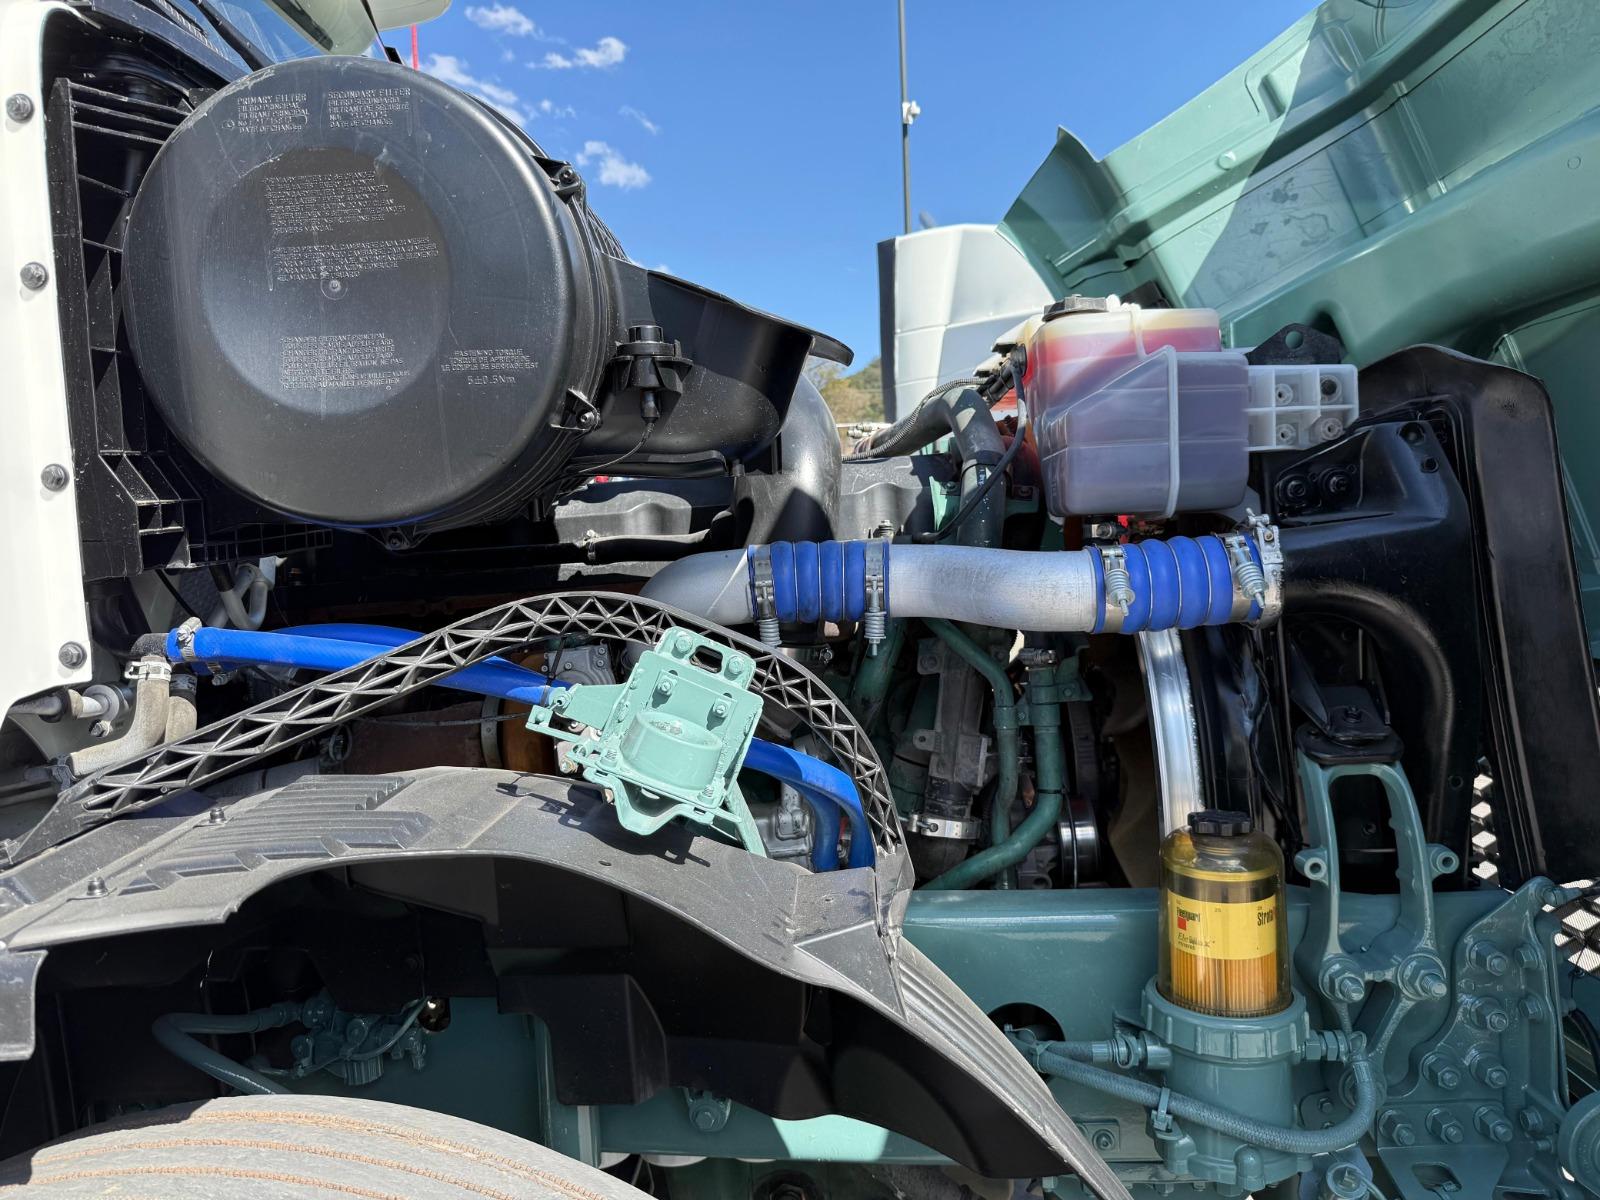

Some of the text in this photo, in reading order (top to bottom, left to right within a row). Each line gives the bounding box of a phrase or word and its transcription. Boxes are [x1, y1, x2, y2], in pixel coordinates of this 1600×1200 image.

[379, 87, 411, 97] FILTER
[237, 93, 307, 105] PRIMARY FILTER
